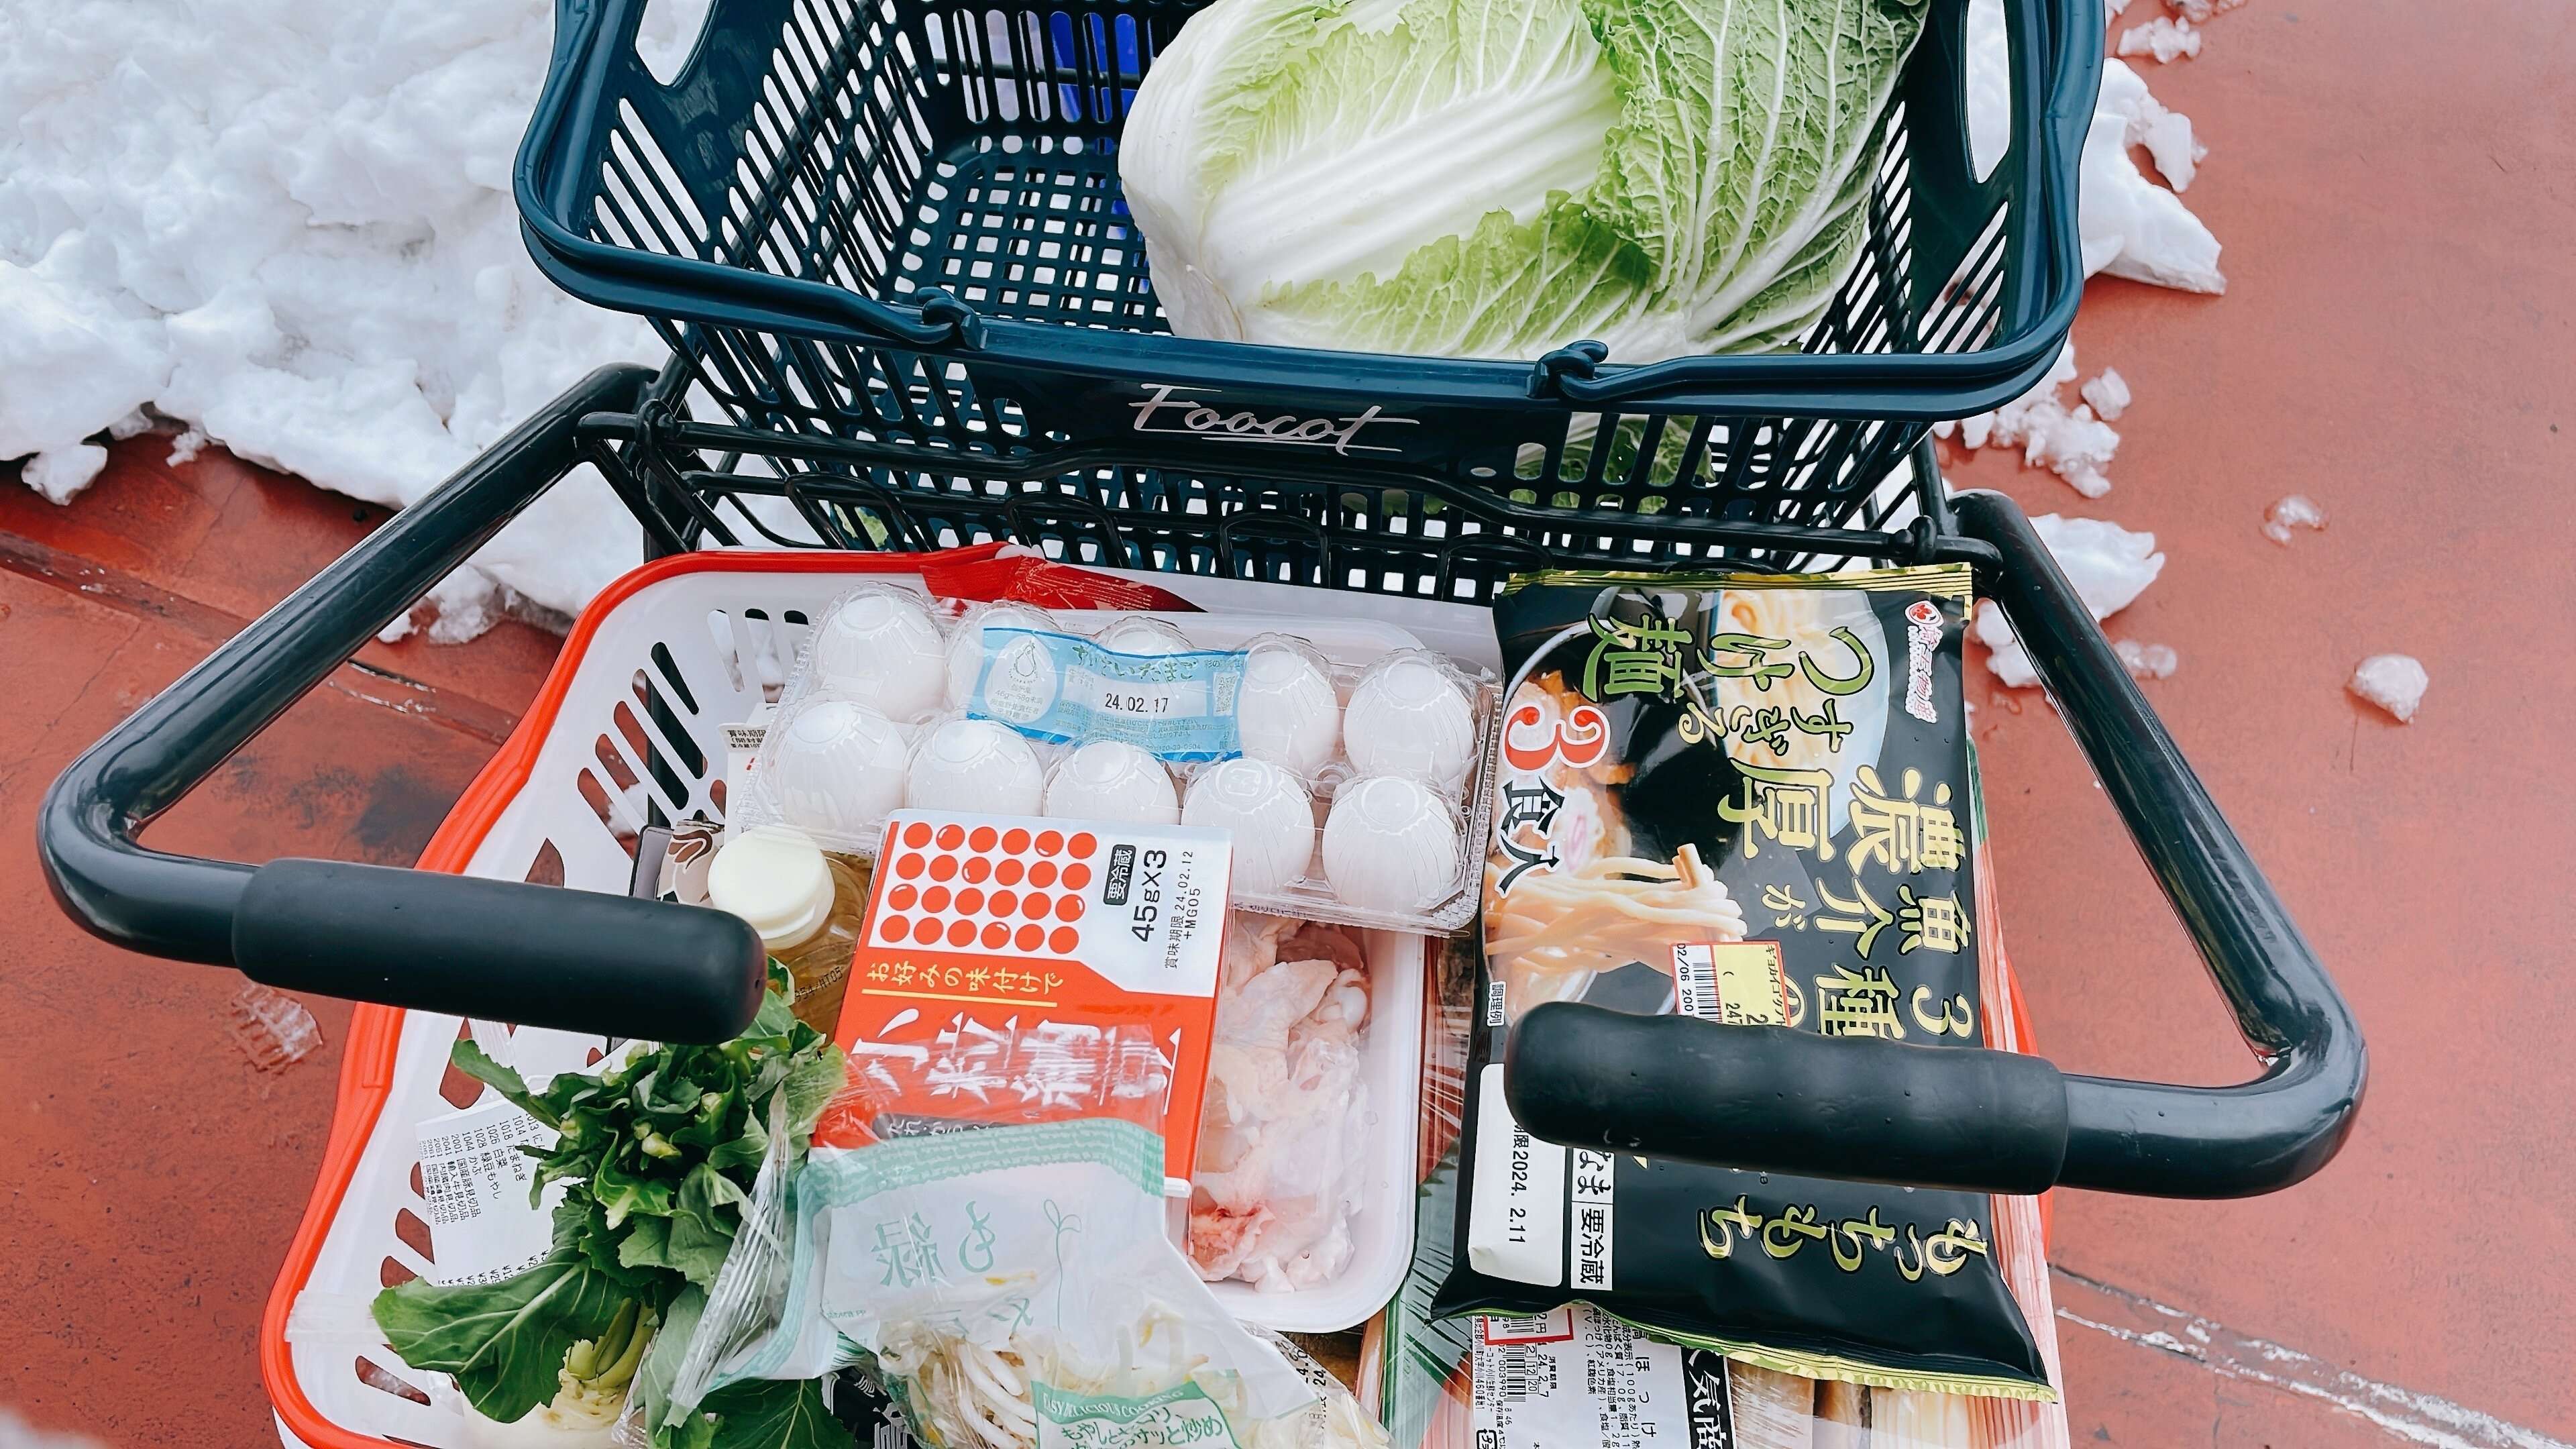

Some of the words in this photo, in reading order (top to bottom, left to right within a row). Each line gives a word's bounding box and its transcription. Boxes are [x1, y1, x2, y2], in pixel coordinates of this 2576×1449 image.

[1128, 383, 1420, 456] Foocot
[1582, 612, 1875, 702] つけ麺
[1914, 625, 1942, 721] 埼玉物産
[1676, 698, 1855, 756] すぎる
[1501, 704, 1611, 896] 3食入
[1719, 757, 1968, 875] 濃厚
[1108, 848, 1134, 900] 要冷蔵
[1165, 916, 1183, 969] 賞味期限
[1174, 851, 1194, 915] 24.02.12
[1761, 878, 1971, 962] 魚介が
[866, 960, 1064, 995] お好みの味付けで
[1676, 943, 1690, 982] 02/06
[1489, 983, 1505, 1024] 調理例
[1682, 989, 1696, 1016] 200
[851, 1008, 1181, 1116] 小粒納豆
[450, 1133, 463, 1154] 2001
[462, 1132, 475, 1152] 1044
[474, 1128, 488, 1149] 1028
[486, 1124, 501, 1144] 1026
[499, 1120, 514, 1140] 1018
[513, 1116, 527, 1136] 1014
[468, 1155, 482, 1176] かぶ
[480, 1152, 502, 1199] 緑豆もやし
[493, 1149, 507, 1169] 白菜
[506, 1144, 527, 1181] たまねぎ
[1580, 1208, 1605, 1285] 要冷蔵
[1698, 1191, 1990, 1285] もっちもち
[1548, 1356, 1557, 1390] 消費期限
